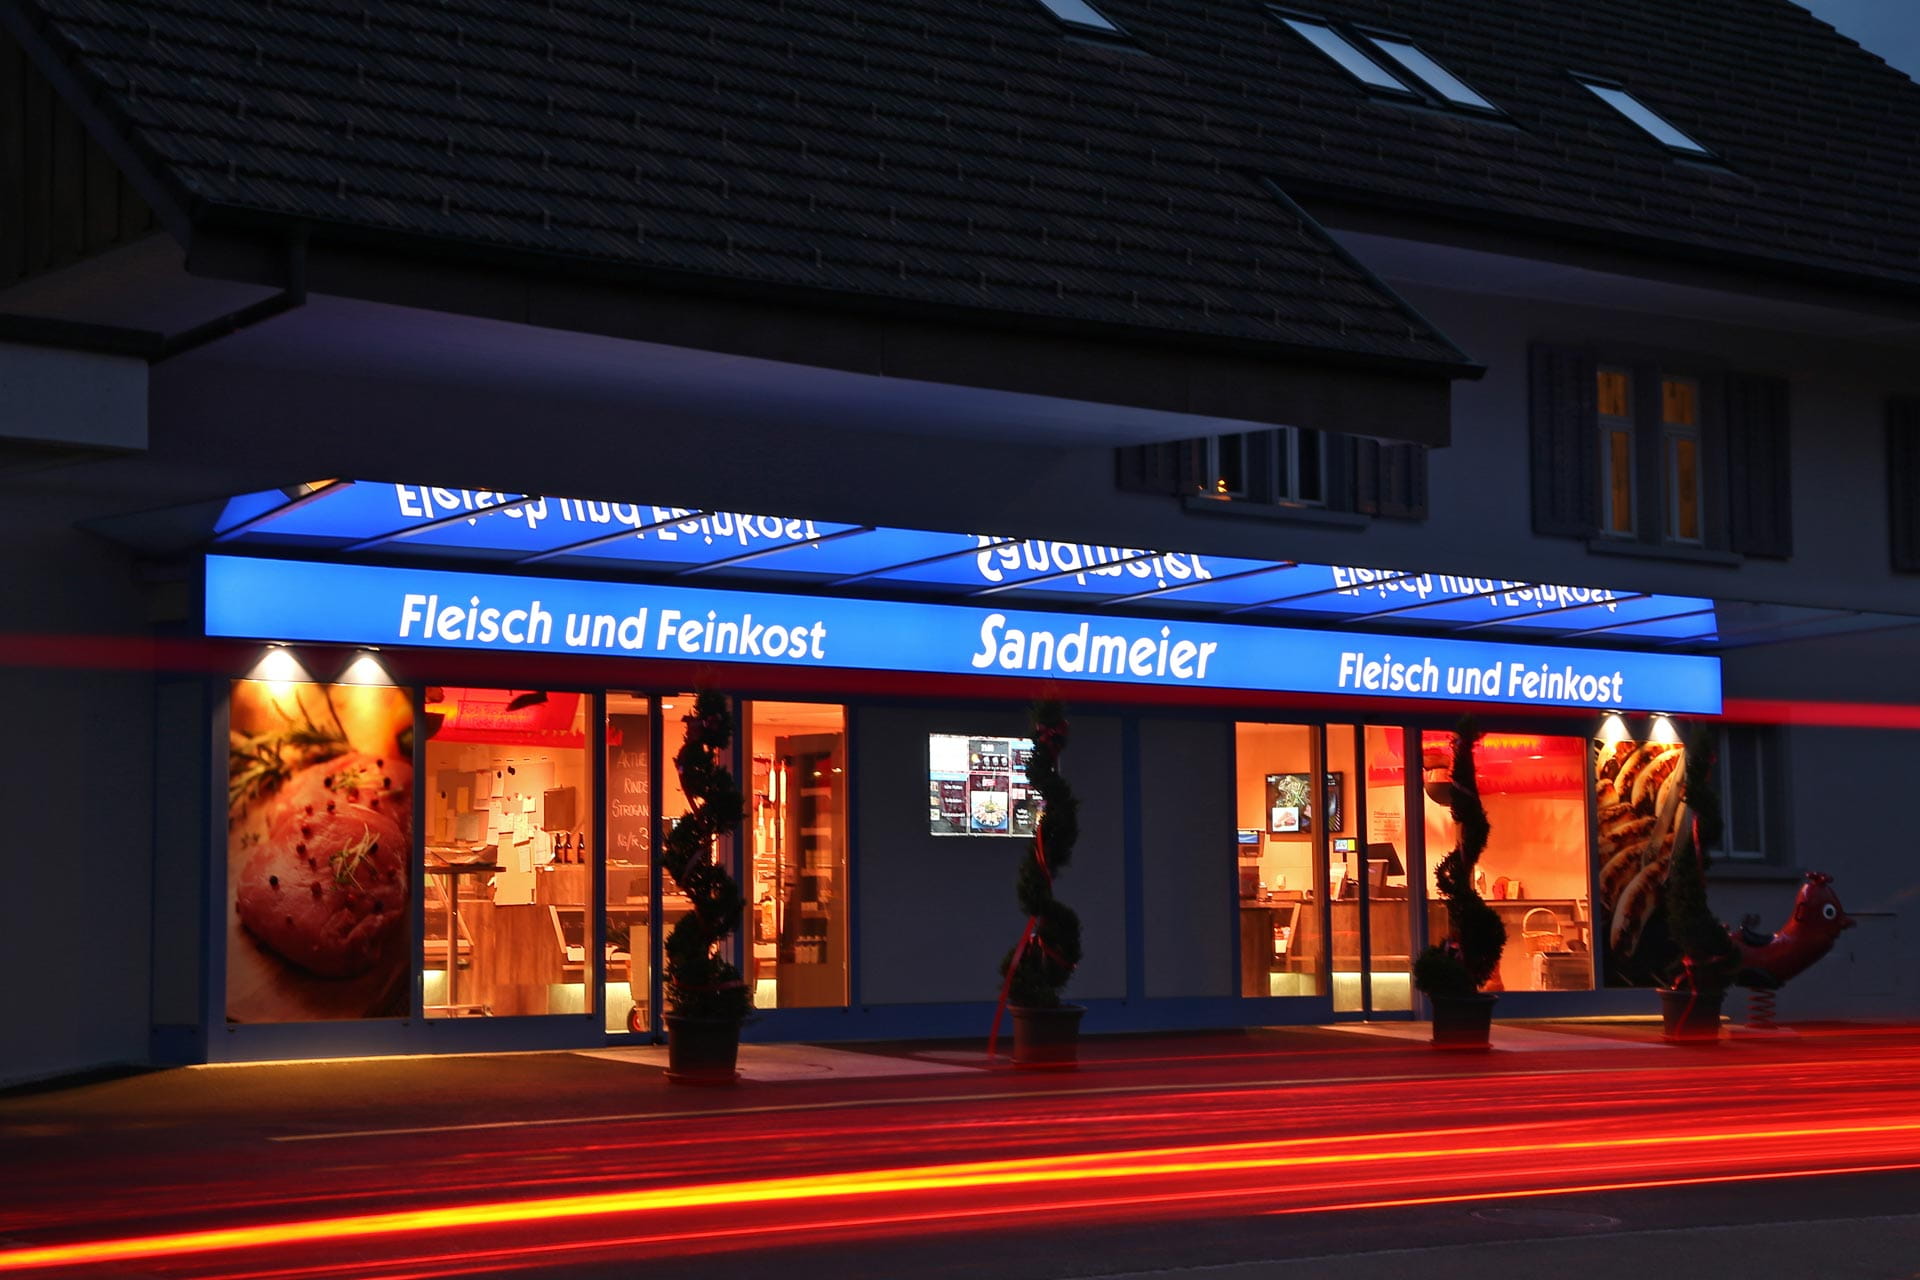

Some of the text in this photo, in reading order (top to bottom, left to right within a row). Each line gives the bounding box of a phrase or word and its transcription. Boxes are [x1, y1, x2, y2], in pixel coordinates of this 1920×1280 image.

[399, 593, 828, 660] Fleisch und Feinkost
[971, 612, 1219, 680] Sandmeier
[1338, 652, 1625, 704] Fleisch und Feinkost
